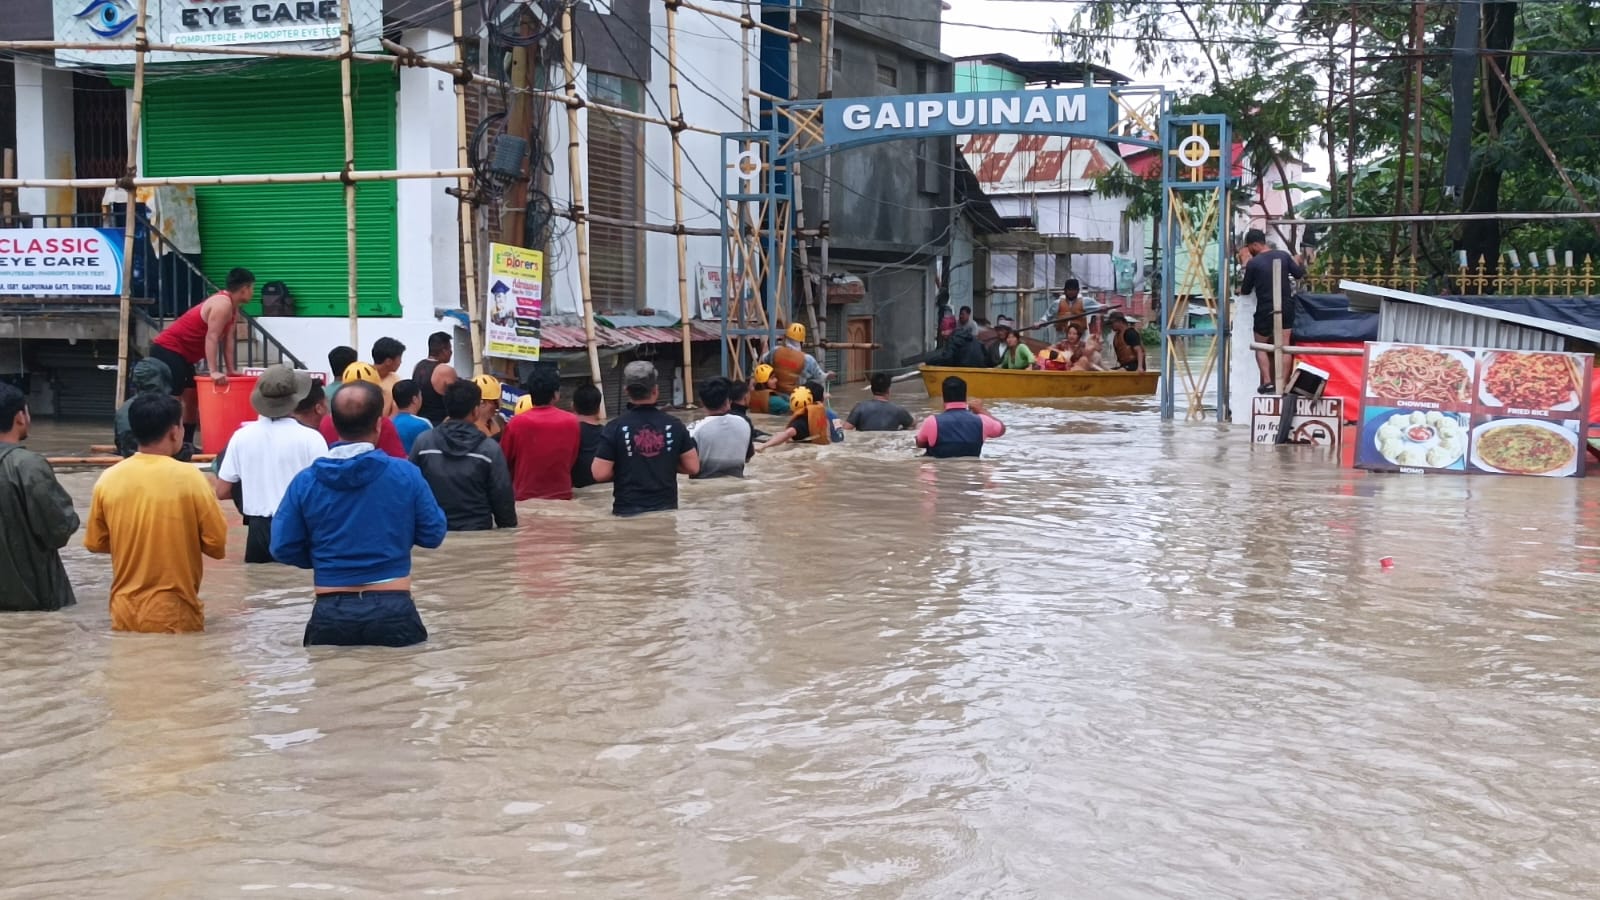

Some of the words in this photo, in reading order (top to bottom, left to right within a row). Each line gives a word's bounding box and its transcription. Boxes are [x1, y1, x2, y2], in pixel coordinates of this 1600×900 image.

[182, 6, 242, 26] EYE
[252, 1, 338, 22] CARE
[244, 29, 299, 40] PHOROPTER
[301, 28, 319, 37] EYE
[842, 94, 1086, 130] GAIPUINAM
[0, 238, 99, 253] CLASSIC
[0, 256, 36, 267] EYE
[43, 256, 100, 267] CARE
[1254, 398, 1274, 414] NO
[1278, 398, 1338, 417] RKING
[1396, 400, 1440, 409] CHOWMEIN
[1507, 407, 1530, 415] FRIED
[1531, 409, 1549, 417] RICE
[1257, 422, 1266, 431] in
[1256, 433, 1268, 442] of
[1399, 466, 1425, 474] MOMO
